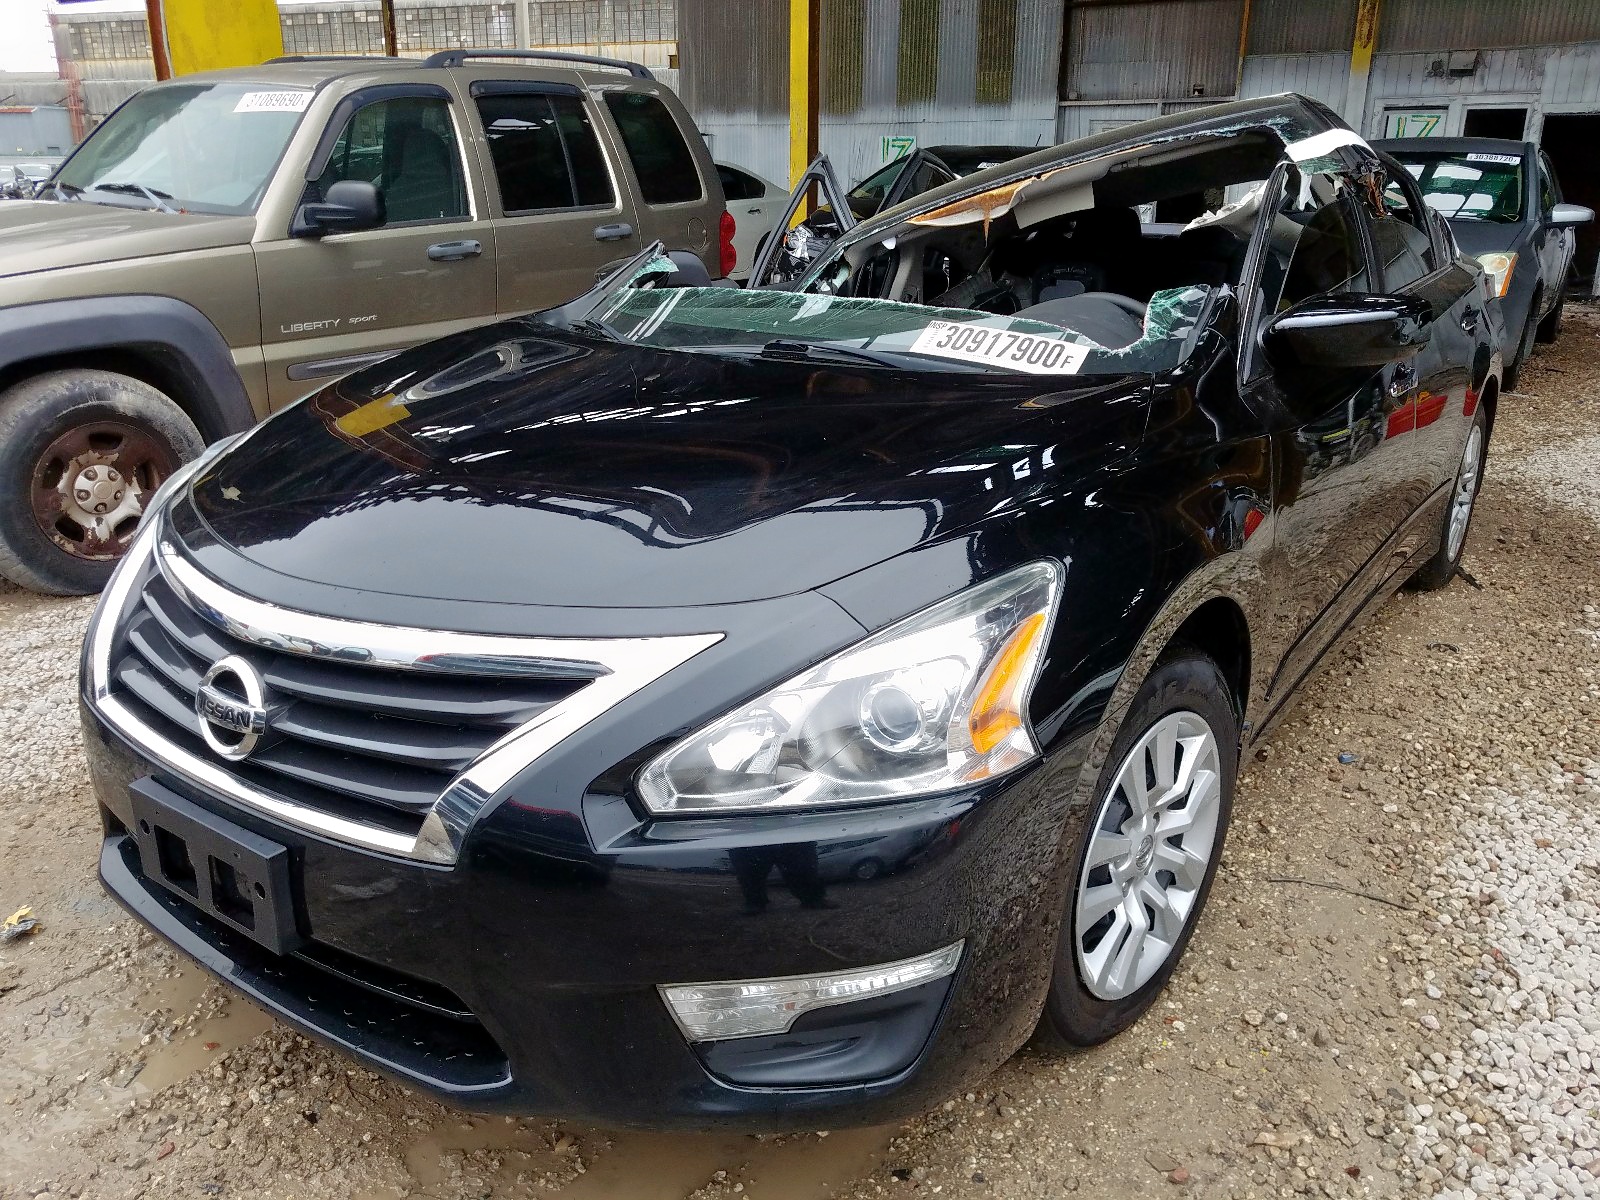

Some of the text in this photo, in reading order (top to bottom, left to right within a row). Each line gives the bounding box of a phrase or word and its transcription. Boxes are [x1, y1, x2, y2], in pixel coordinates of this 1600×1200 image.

[1396, 114, 1441, 138] 17
[882, 136, 914, 163] 17
[280, 314, 377, 333] LIBERTY sport
[929, 321, 948, 330] INSP
[936, 325, 1066, 369] 30917900
